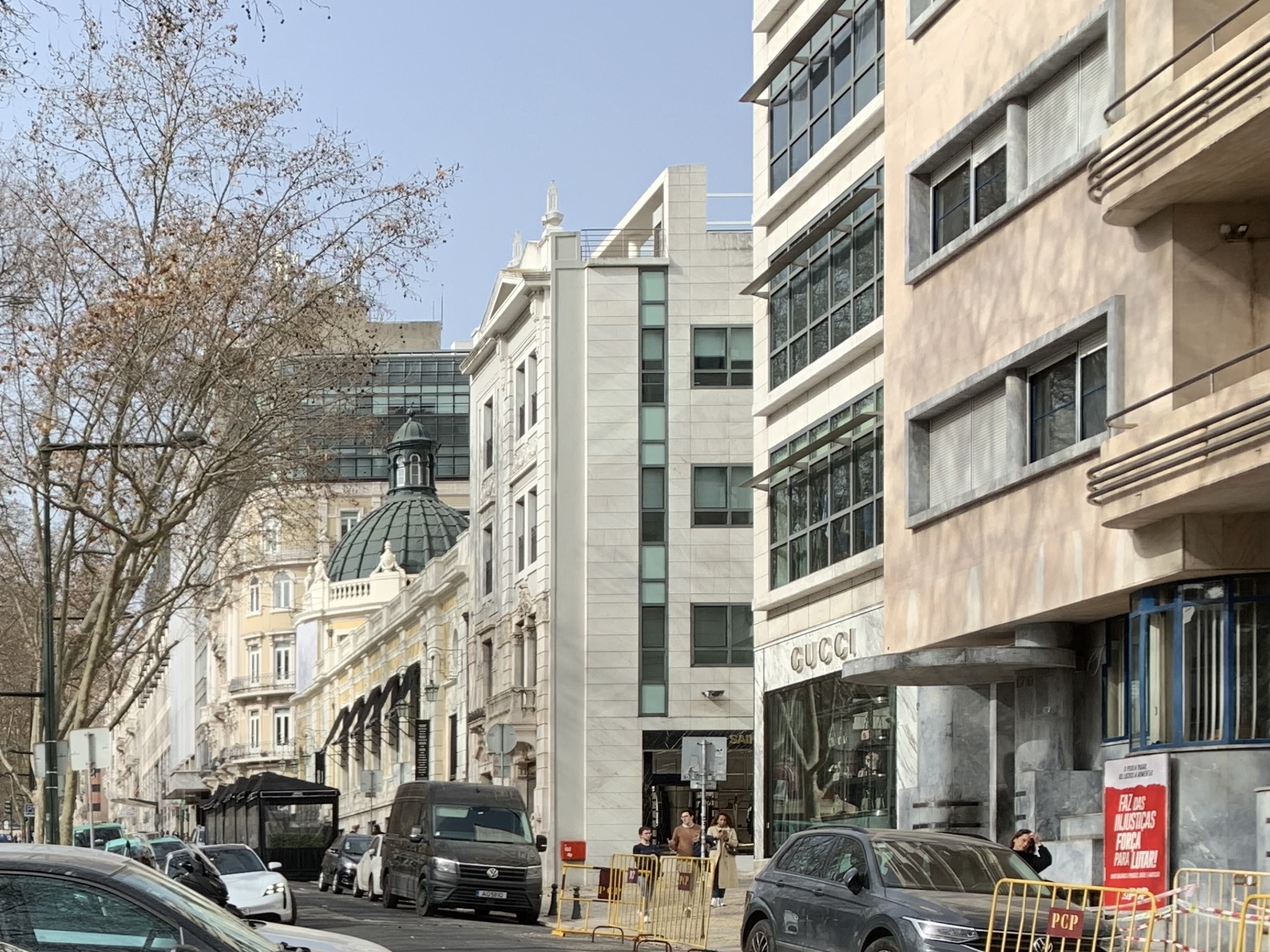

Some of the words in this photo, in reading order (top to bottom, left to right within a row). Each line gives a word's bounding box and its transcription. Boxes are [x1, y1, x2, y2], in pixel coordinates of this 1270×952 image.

[791, 628, 856, 674] GUCCI
[730, 734, 753, 745] SAI
[1118, 793, 1133, 812] FAZ
[1132, 795, 1146, 811] DAS
[1114, 810, 1157, 832] INJUSTIÇAS
[1115, 831, 1142, 852] FORÇA
[1114, 852, 1130, 867] PARA
[1130, 850, 1158, 869] LUTAR!
[1051, 912, 1079, 931] PCP
